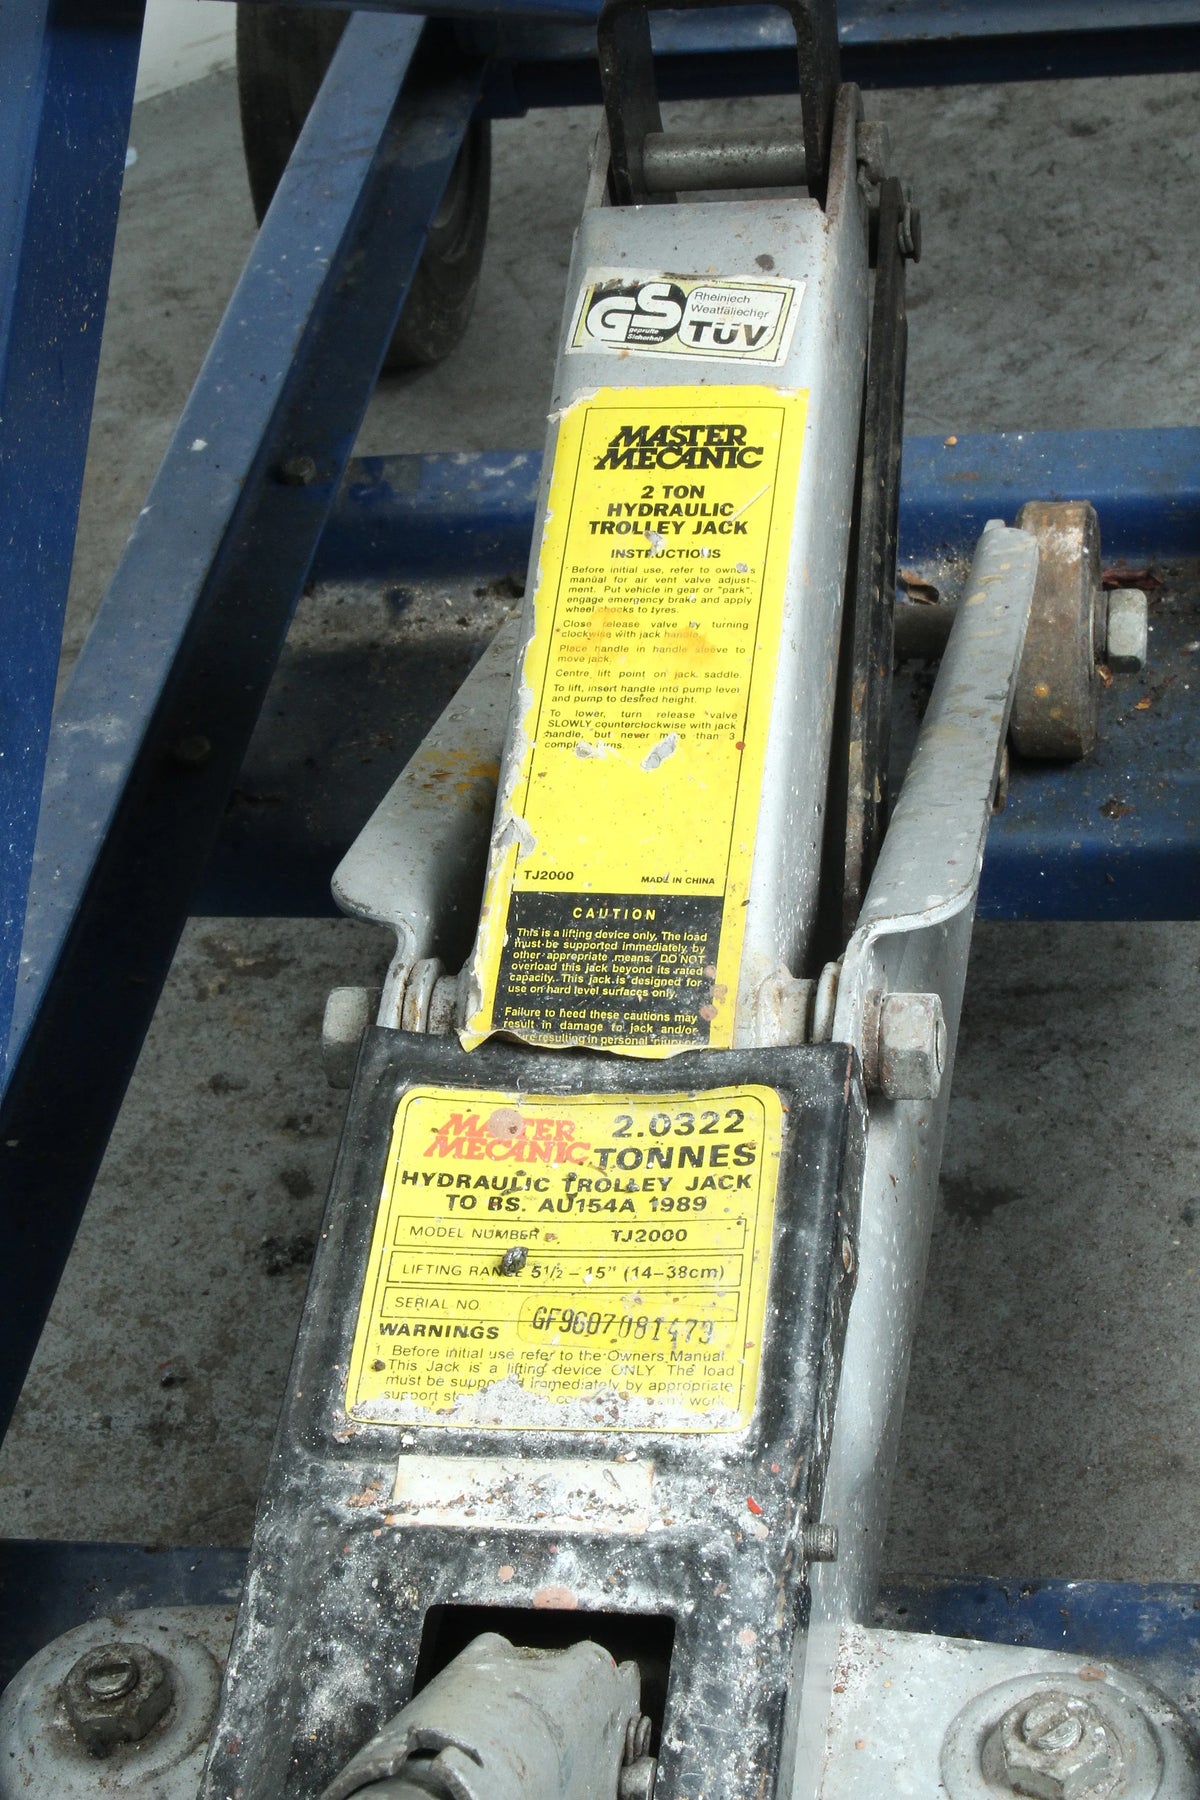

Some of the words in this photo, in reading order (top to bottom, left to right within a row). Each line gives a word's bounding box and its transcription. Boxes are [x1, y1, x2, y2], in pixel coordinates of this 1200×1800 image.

[586, 282, 683, 342] GS
[688, 321, 769, 347] TÜV
[608, 424, 747, 447] MASTER
[594, 446, 763, 470] MECANIC
[641, 485, 655, 499] 2
[663, 485, 705, 499] TON
[607, 503, 735, 517] HYDRAULIC
[589, 521, 686, 535] TROLLEY
[692, 520, 749, 535] JACK
[571, 566, 605, 574] Before
[670, 566, 694, 574] refer
[569, 576, 607, 584] manual
[677, 587, 699, 595] gear
[567, 597, 604, 605] engage
[608, 597, 664, 605] emergency
[724, 597, 752, 605] apply
[712, 622, 749, 630] turning
[639, 631, 661, 639] jack
[554, 684, 565, 692] To
[620, 685, 656, 693] handle
[574, 696, 603, 704] pump
[620, 695, 659, 703] desired
[550, 709, 561, 717] To
[548, 720, 592, 728] SLOWLY
[594, 720, 687, 729] counterclockwise
[714, 722, 737, 731] jack
[696, 732, 719, 740] than
[728, 732, 735, 740] 3
[524, 870, 574, 881] TJ2000
[685, 877, 716, 885] CHINA
[572, 907, 657, 921] CAUTION
[517, 928, 539, 937] This
[541, 928, 551, 937] is
[562, 928, 592, 940] lifting
[595, 929, 630, 939] device
[661, 931, 681, 941] The
[683, 932, 708, 942] load
[514, 940, 541, 948] must
[545, 940, 560, 949] be
[563, 940, 618, 952] supported
[622, 941, 687, 954] immediately
[692, 943, 706, 955] by
[513, 951, 541, 960] other
[547, 953, 608, 964] appropriate
[660, 954, 677, 964] DO
[680, 955, 706, 964] NOT
[511, 962, 557, 971] overload
[561, 963, 582, 972] this
[585, 963, 608, 974] jack
[612, 964, 653, 976] beyond
[657, 965, 671, 974] its
[675, 966, 704, 976] rated
[561, 974, 584, 983] This
[588, 974, 611, 986] jack
[616, 975, 626, 984] is
[631, 976, 681, 989] designed
[686, 978, 703, 987] for
[547, 985, 571, 994] hard
[574, 985, 599, 995] level
[602, 987, 649, 997] surfaces
[652, 989, 678, 1000] only.
[504, 1007, 541, 1017] Failure
[545, 1008, 556, 1017] to
[559, 1009, 586, 1018] heed
[590, 1010, 620, 1020] these
[623, 1011, 670, 1021] cautions
[674, 1015, 698, 1024] may
[503, 1019, 535, 1029] result
[541, 1020, 552, 1029] in
[560, 1020, 603, 1032] damage
[611, 1023, 623, 1032] to
[630, 1023, 653, 1034] jack
[661, 1025, 698, 1035] and/or
[588, 1035, 598, 1044] in
[601, 1036, 648, 1047] personal
[612, 1109, 744, 1138] 2.0322
[424, 1136, 590, 1164] MECANIC
[594, 1143, 757, 1170] TONNES
[401, 1170, 550, 1192] HYDRAULIC
[563, 1176, 673, 1193] TROLLEY
[685, 1174, 752, 1191] JACK
[446, 1194, 477, 1210] TO
[487, 1195, 526, 1212] BS.
[537, 1196, 636, 1213] AU154A
[651, 1196, 708, 1213] 1989
[409, 1225, 464, 1238] MODEL
[471, 1227, 541, 1240] NUMBER
[611, 1229, 688, 1243] TJ2000
[402, 1264, 463, 1277] LIFTING
[395, 1297, 450, 1310] SERIAL
[456, 1299, 480, 1310] NO
[379, 1323, 500, 1340] WARNINGS
[392, 1345, 440, 1357] Before
[445, 1348, 484, 1359] initial
[489, 1351, 515, 1360] use
[520, 1349, 555, 1360] refer
[560, 1351, 573, 1361] to
[579, 1351, 601, 1361] the
[607, 1350, 665, 1362] Owners
[389, 1359, 418, 1371] This
[426, 1360, 460, 1373] Jack
[469, 1361, 480, 1373] is
[489, 1364, 498, 1373] a
[506, 1362, 546, 1377] lifting
[554, 1364, 602, 1376] device
[667, 1364, 695, 1377] The
[703, 1365, 735, 1377] load
[386, 1375, 421, 1386] must
[427, 1375, 445, 1387] be
[625, 1380, 643, 1391] by
